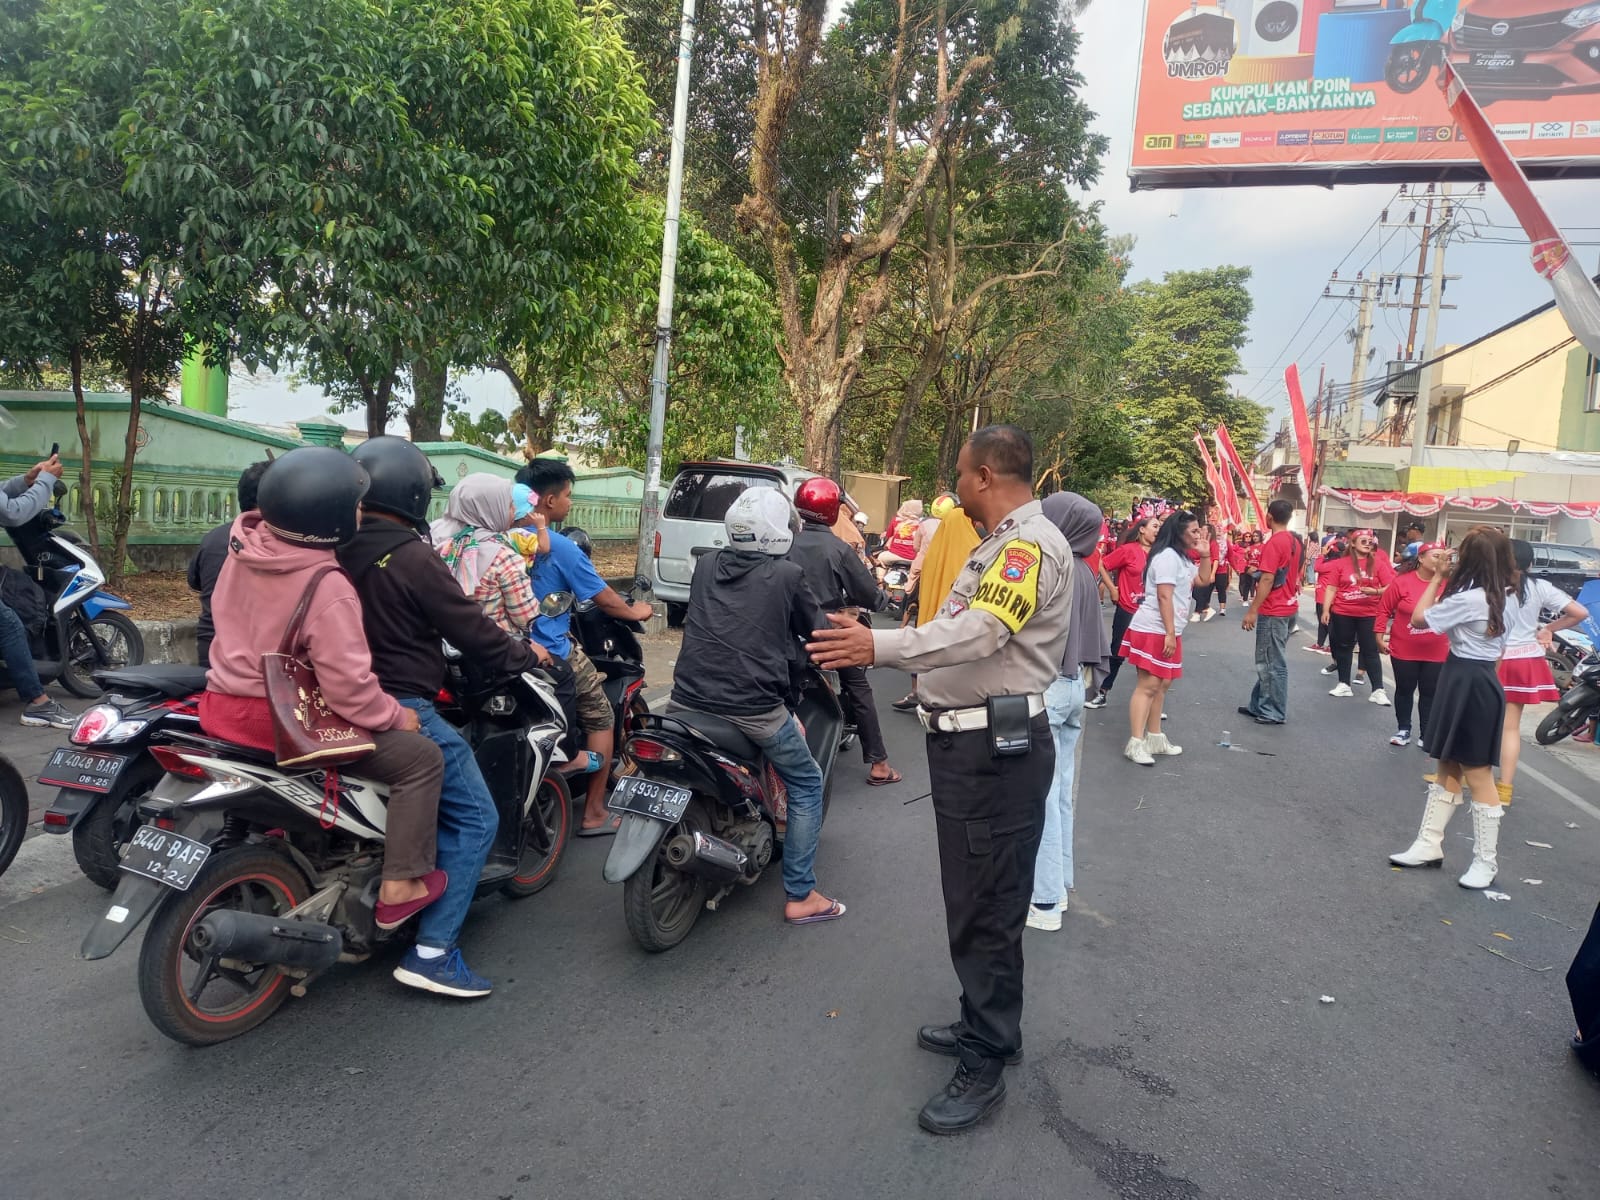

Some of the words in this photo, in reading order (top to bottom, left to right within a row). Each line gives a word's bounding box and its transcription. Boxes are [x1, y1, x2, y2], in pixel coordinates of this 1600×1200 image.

[1167, 61, 1230, 77] UMROH
[1211, 80, 1308, 101] KUMPULKAN
[1312, 78, 1351, 93] POIN
[1183, 91, 1376, 118] SEBANYAK-BANYAKNYA
[303, 535, 340, 543] Classic
[975, 582, 1014, 609] OLISI
[1009, 594, 1032, 623] RW
[53, 752, 64, 765] N
[65, 755, 93, 770] 4048
[96, 759, 119, 775] BAR
[267, 778, 318, 806] 125
[617, 779, 627, 792] N
[631, 781, 660, 798] 4933
[663, 790, 688, 805] EAP
[133, 830, 166, 851] 5440
[167, 840, 204, 864] BAF
